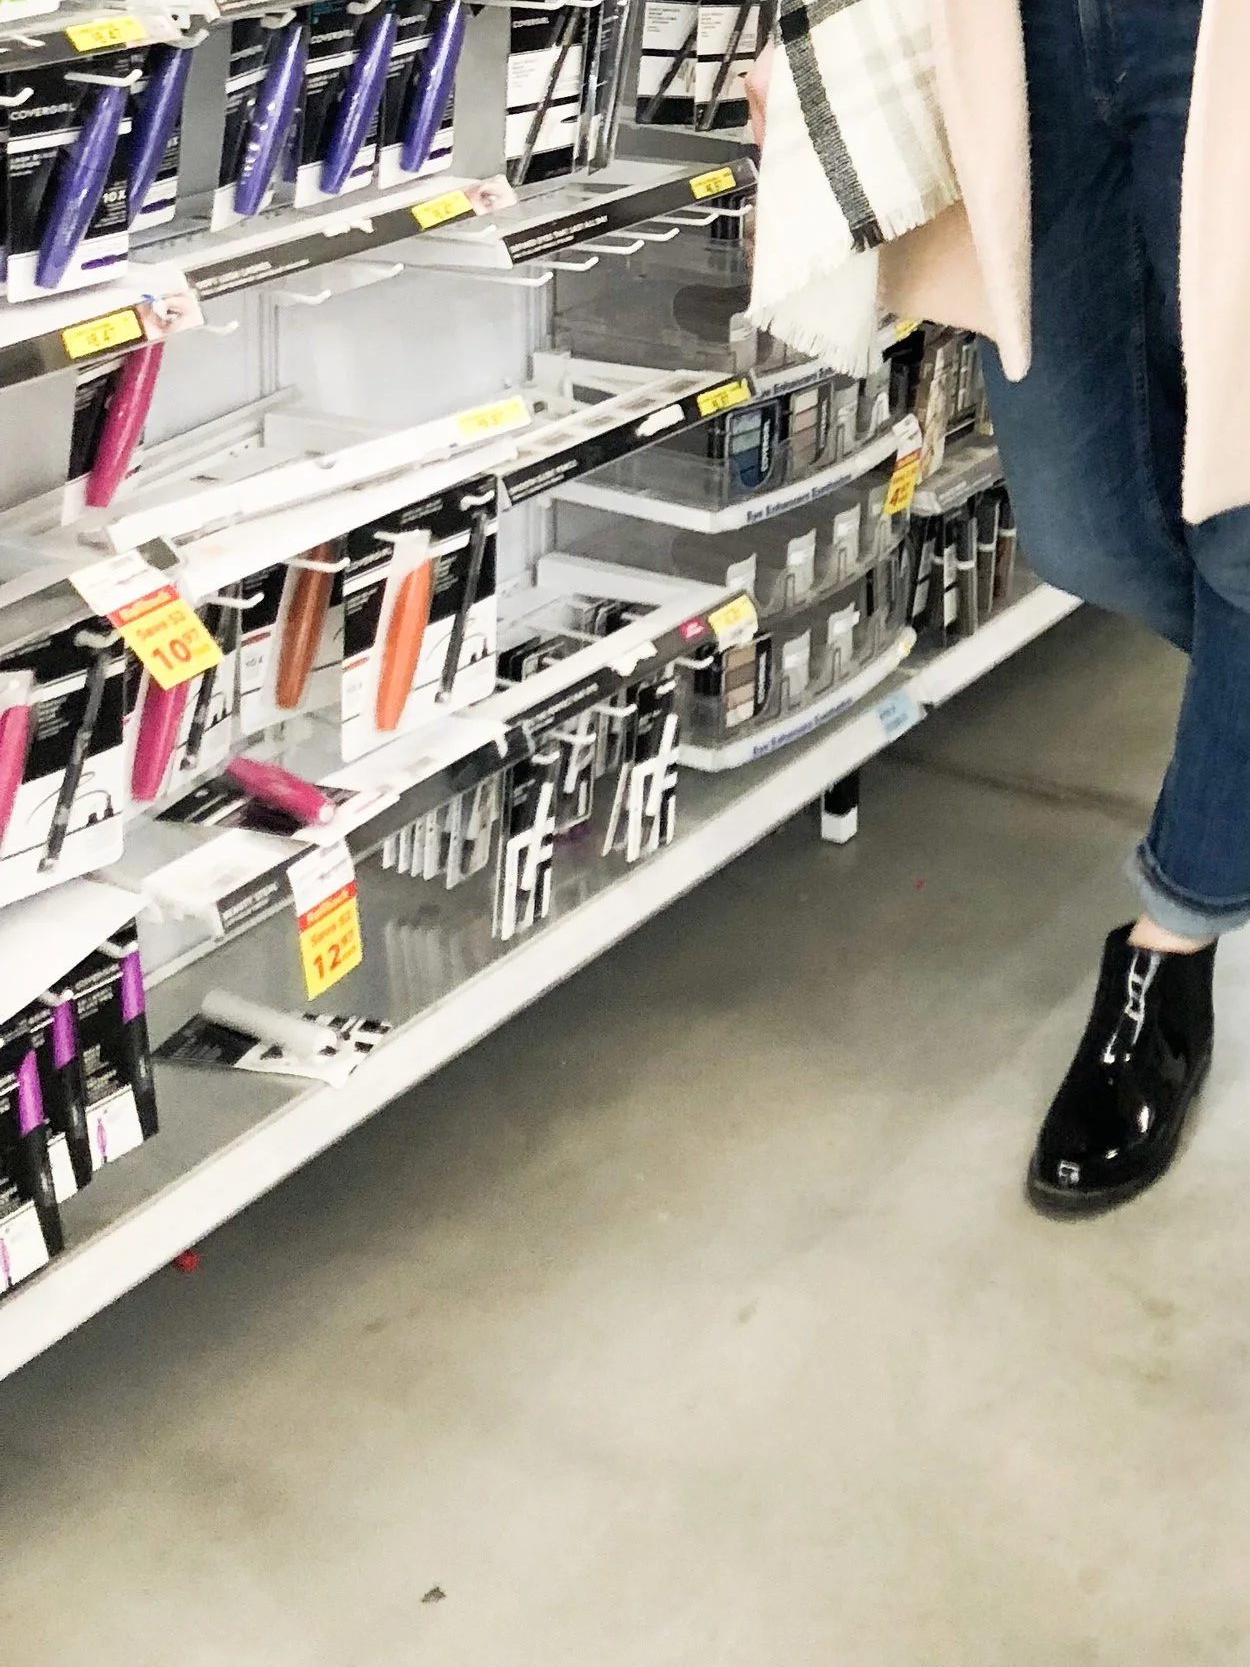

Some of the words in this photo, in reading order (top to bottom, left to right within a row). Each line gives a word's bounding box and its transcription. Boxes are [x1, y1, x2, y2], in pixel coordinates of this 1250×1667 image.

[8, 103, 76, 121] COVERGIRL
[103, 189, 127, 204] 10X
[151, 639, 192, 671] 10
[313, 944, 342, 980] 12
